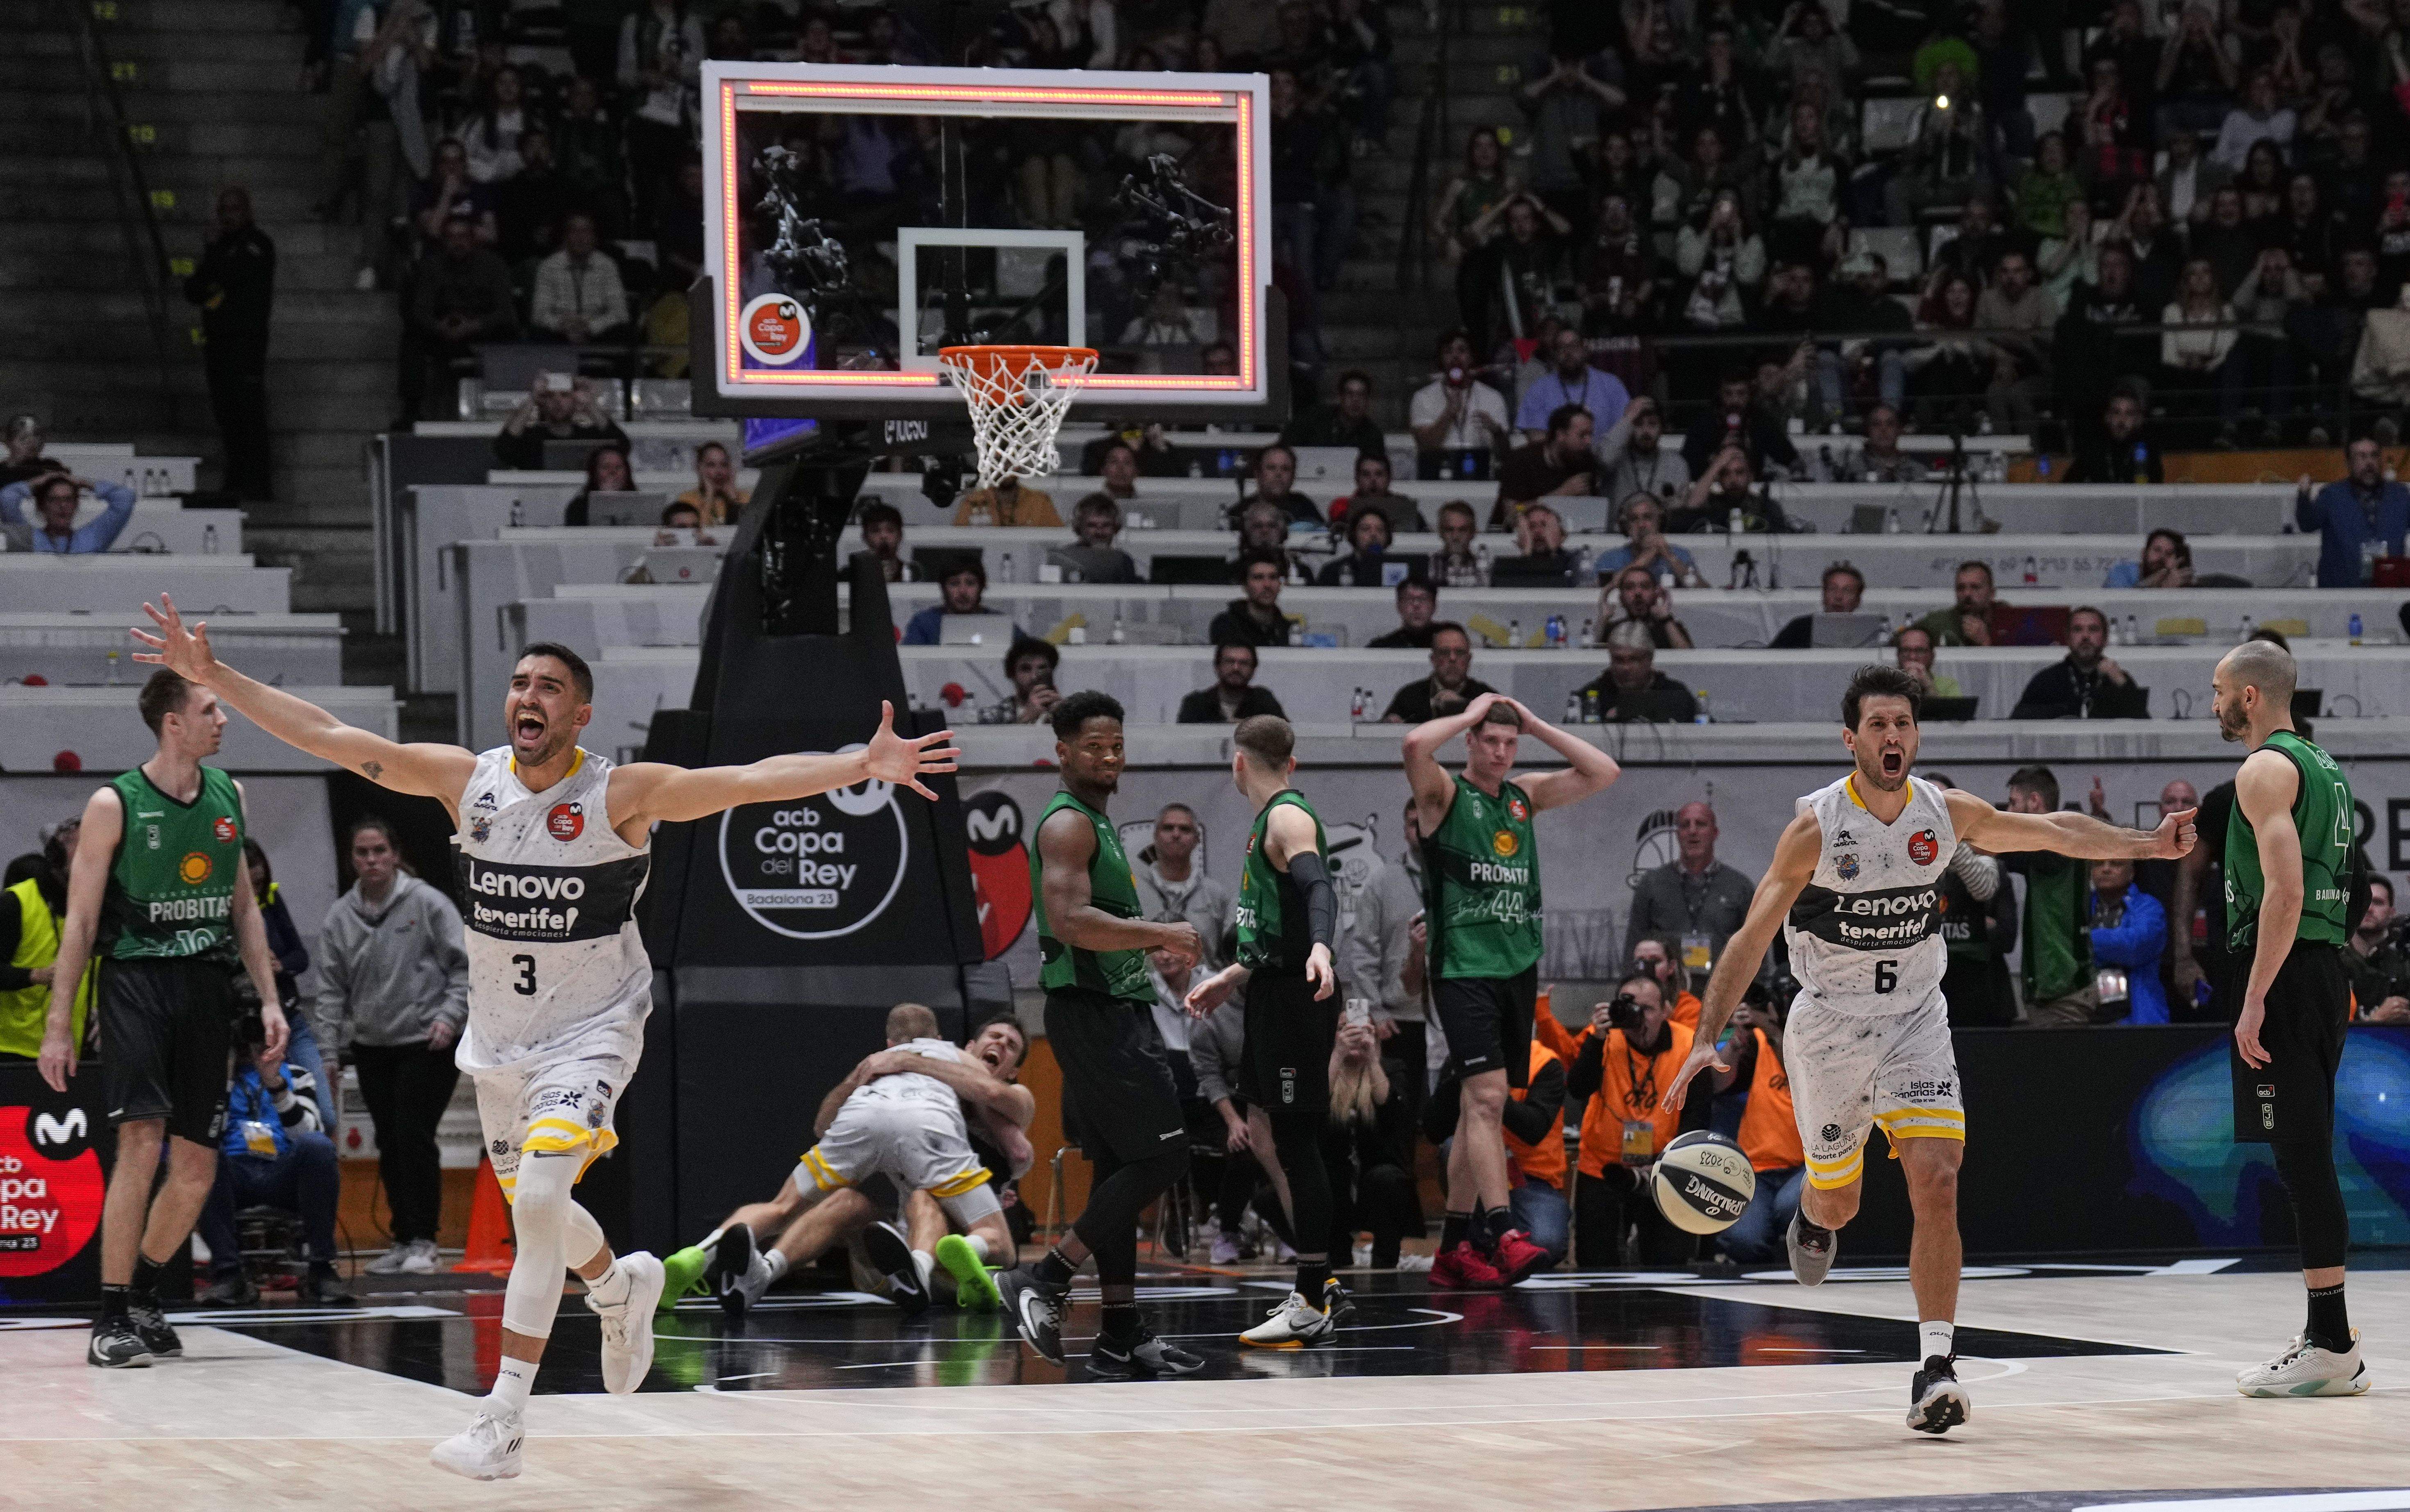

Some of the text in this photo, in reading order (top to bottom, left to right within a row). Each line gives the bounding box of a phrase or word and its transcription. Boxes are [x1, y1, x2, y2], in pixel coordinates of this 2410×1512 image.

[773, 806, 821, 827] acb
[754, 826, 844, 858] Copa
[469, 860, 585, 900] Lenovo
[760, 857, 858, 890] del Rey
[747, 894, 813, 904] Badalona
[1491, 889, 1523, 924] 44
[1834, 890, 1937, 916] Lenovo
[1840, 935, 1922, 947] despierta emociones
[511, 954, 537, 996] 3
[1874, 960, 1898, 994] 6
[1911, 1081, 1935, 1090] Islas
[1811, 1132, 1857, 1153] LA LAGUNA
[1811, 1152, 1837, 1161] deporte
[1838, 1145, 1853, 1158] para
[1699, 1151, 1723, 1167] 2023
[0, 1204, 60, 1234] Rey
